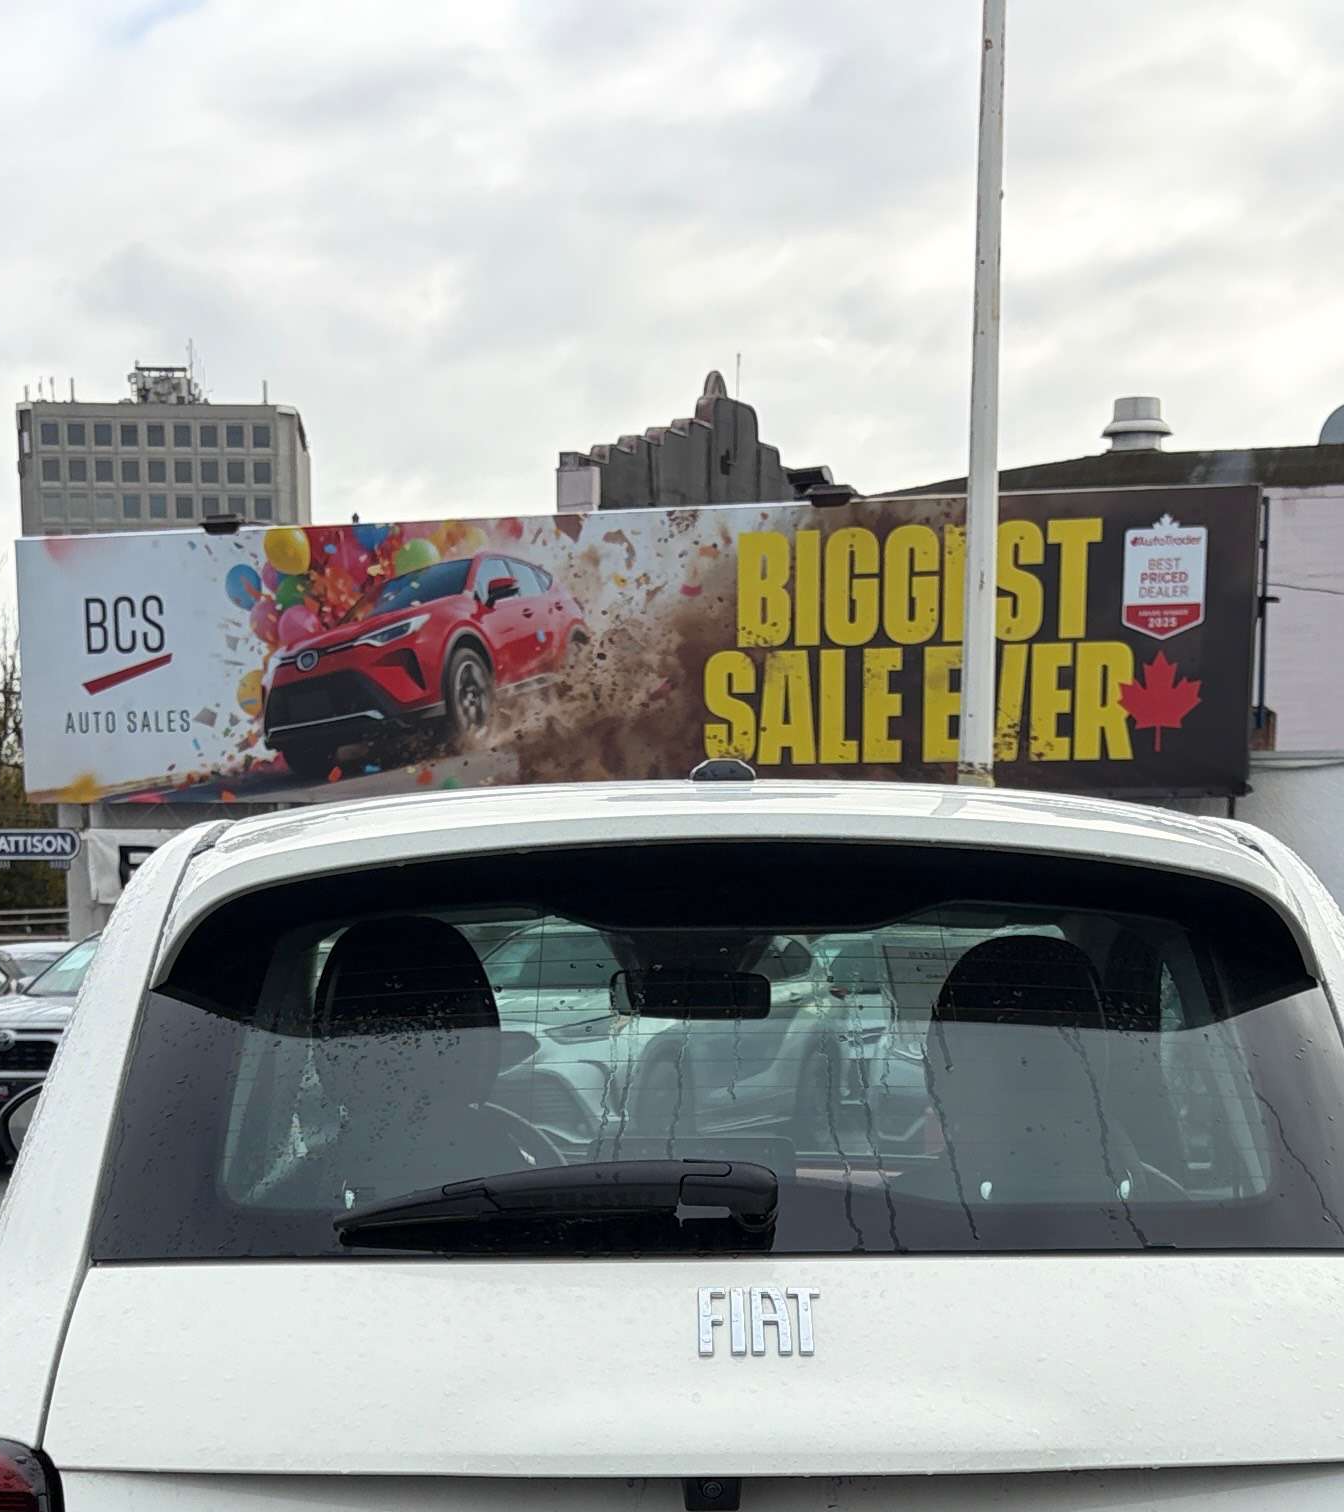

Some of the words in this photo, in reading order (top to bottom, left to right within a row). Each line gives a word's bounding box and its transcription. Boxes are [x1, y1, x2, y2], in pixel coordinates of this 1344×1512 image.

[1148, 557, 1181, 570] BEST
[1140, 571, 1188, 584] PRICED
[1138, 585, 1189, 598] DEALER
[84, 595, 165, 654] BCS
[703, 647, 904, 765] SALE
[65, 711, 117, 735] AUTO
[127, 709, 191, 733] SALES
[697, 1286, 821, 1358] FIAT
